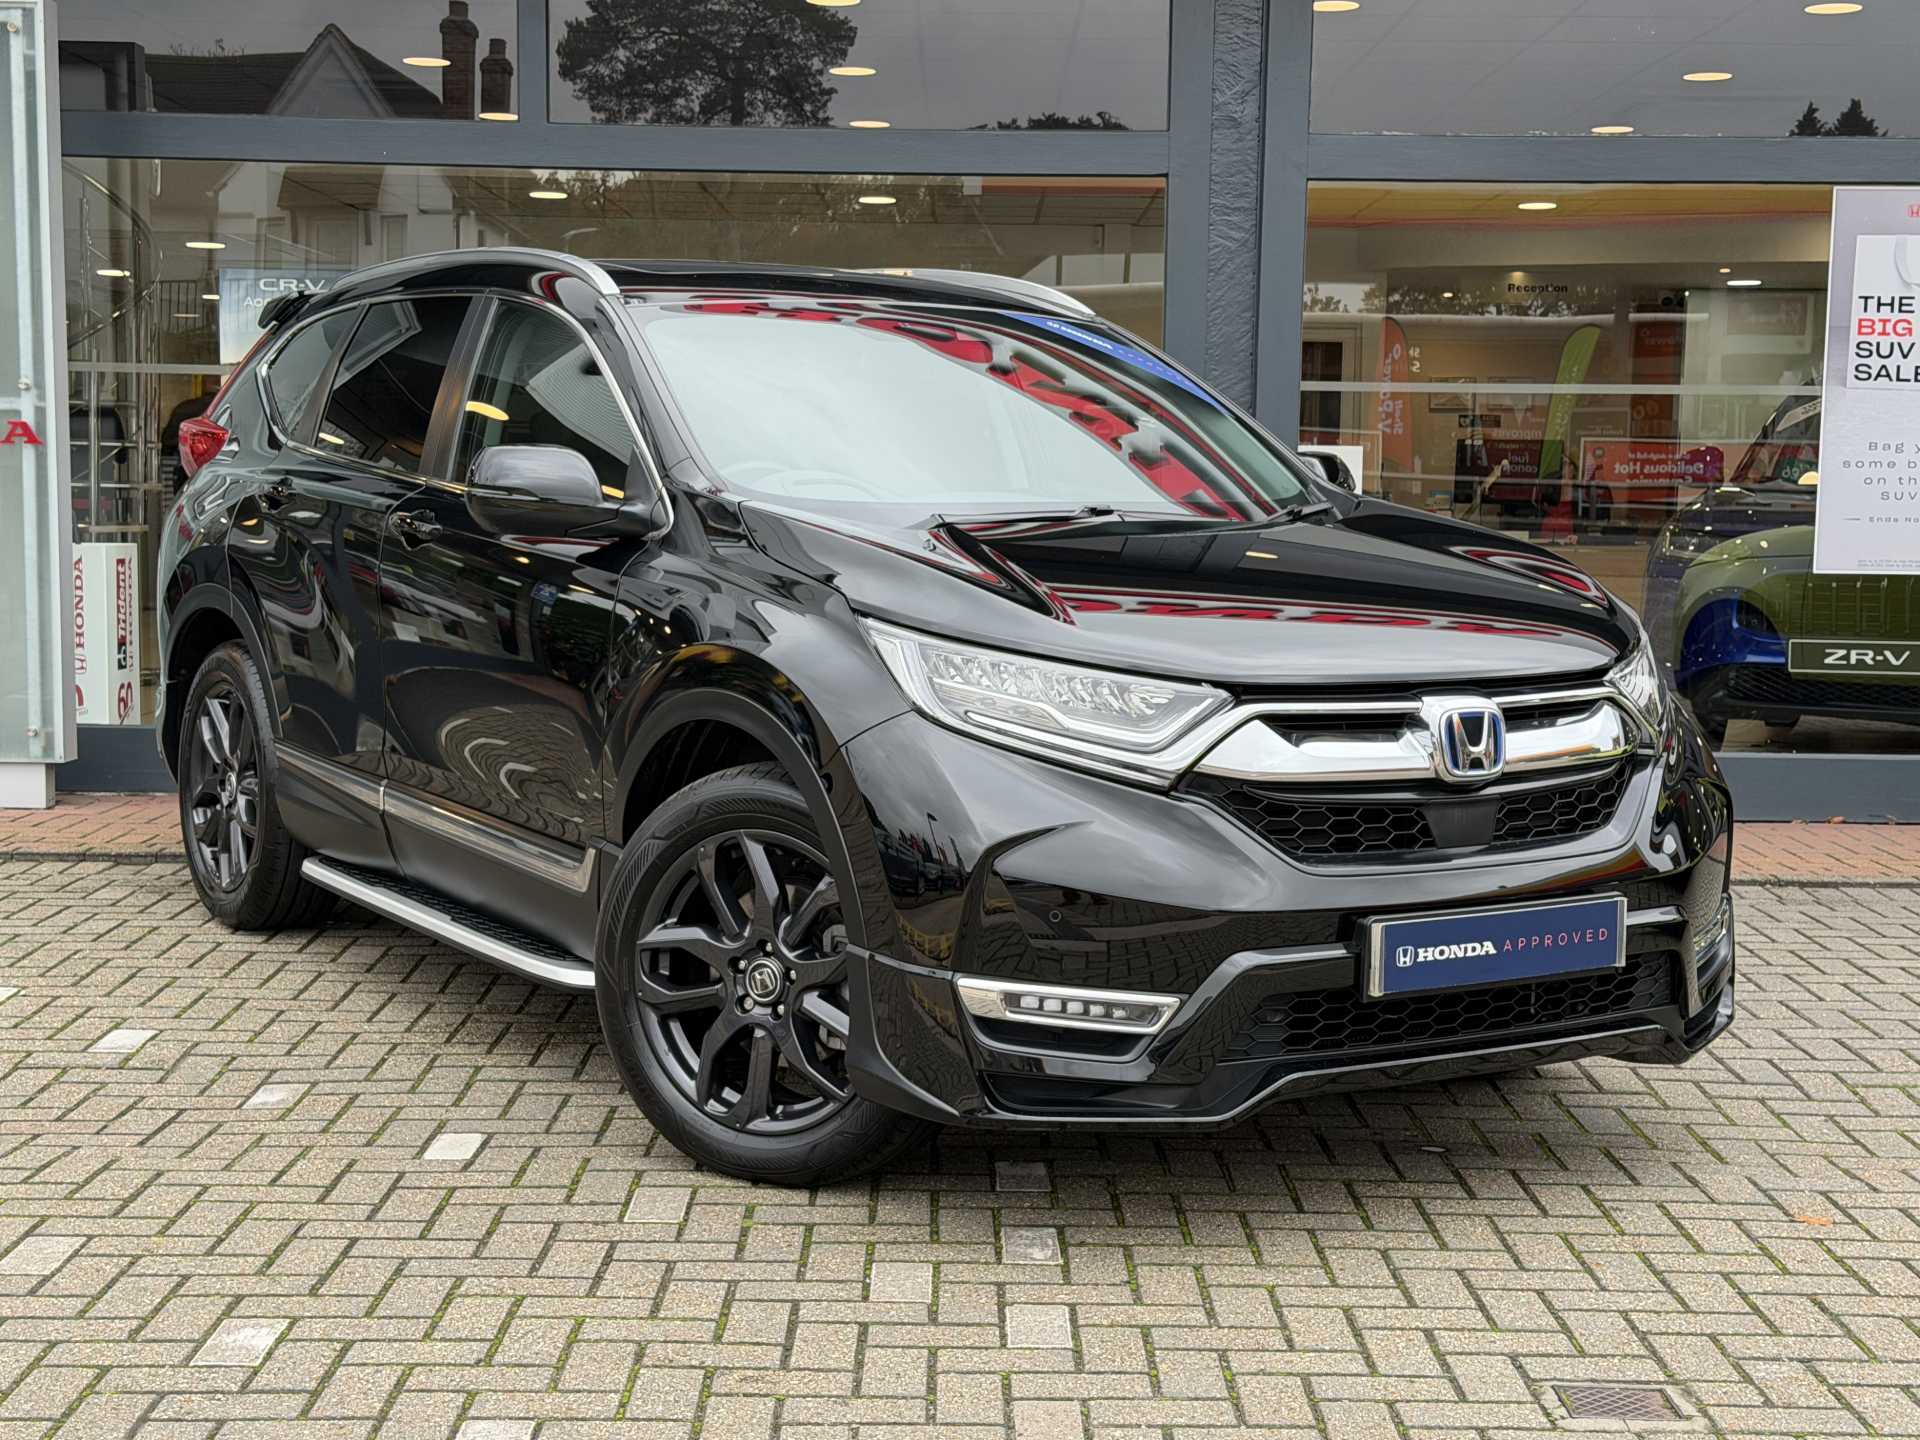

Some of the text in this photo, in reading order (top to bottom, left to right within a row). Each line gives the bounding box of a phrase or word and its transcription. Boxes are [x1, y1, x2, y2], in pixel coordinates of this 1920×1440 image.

[259, 278, 326, 292] CR-V
[1858, 295, 1916, 314] THE
[1856, 318, 1913, 337] BIG
[1854, 341, 1916, 360] SUV
[0, 421, 43, 446] A
[1868, 441, 1905, 455] Bag
[1842, 460, 1897, 469] some
[1863, 476, 1887, 486] on
[1880, 490, 1918, 501] SUV
[74, 555, 85, 649] HONDA
[117, 561, 127, 640] Trident
[1823, 648, 1911, 666] ZR-V
[1416, 928, 1608, 962] HONDA APPROVED
